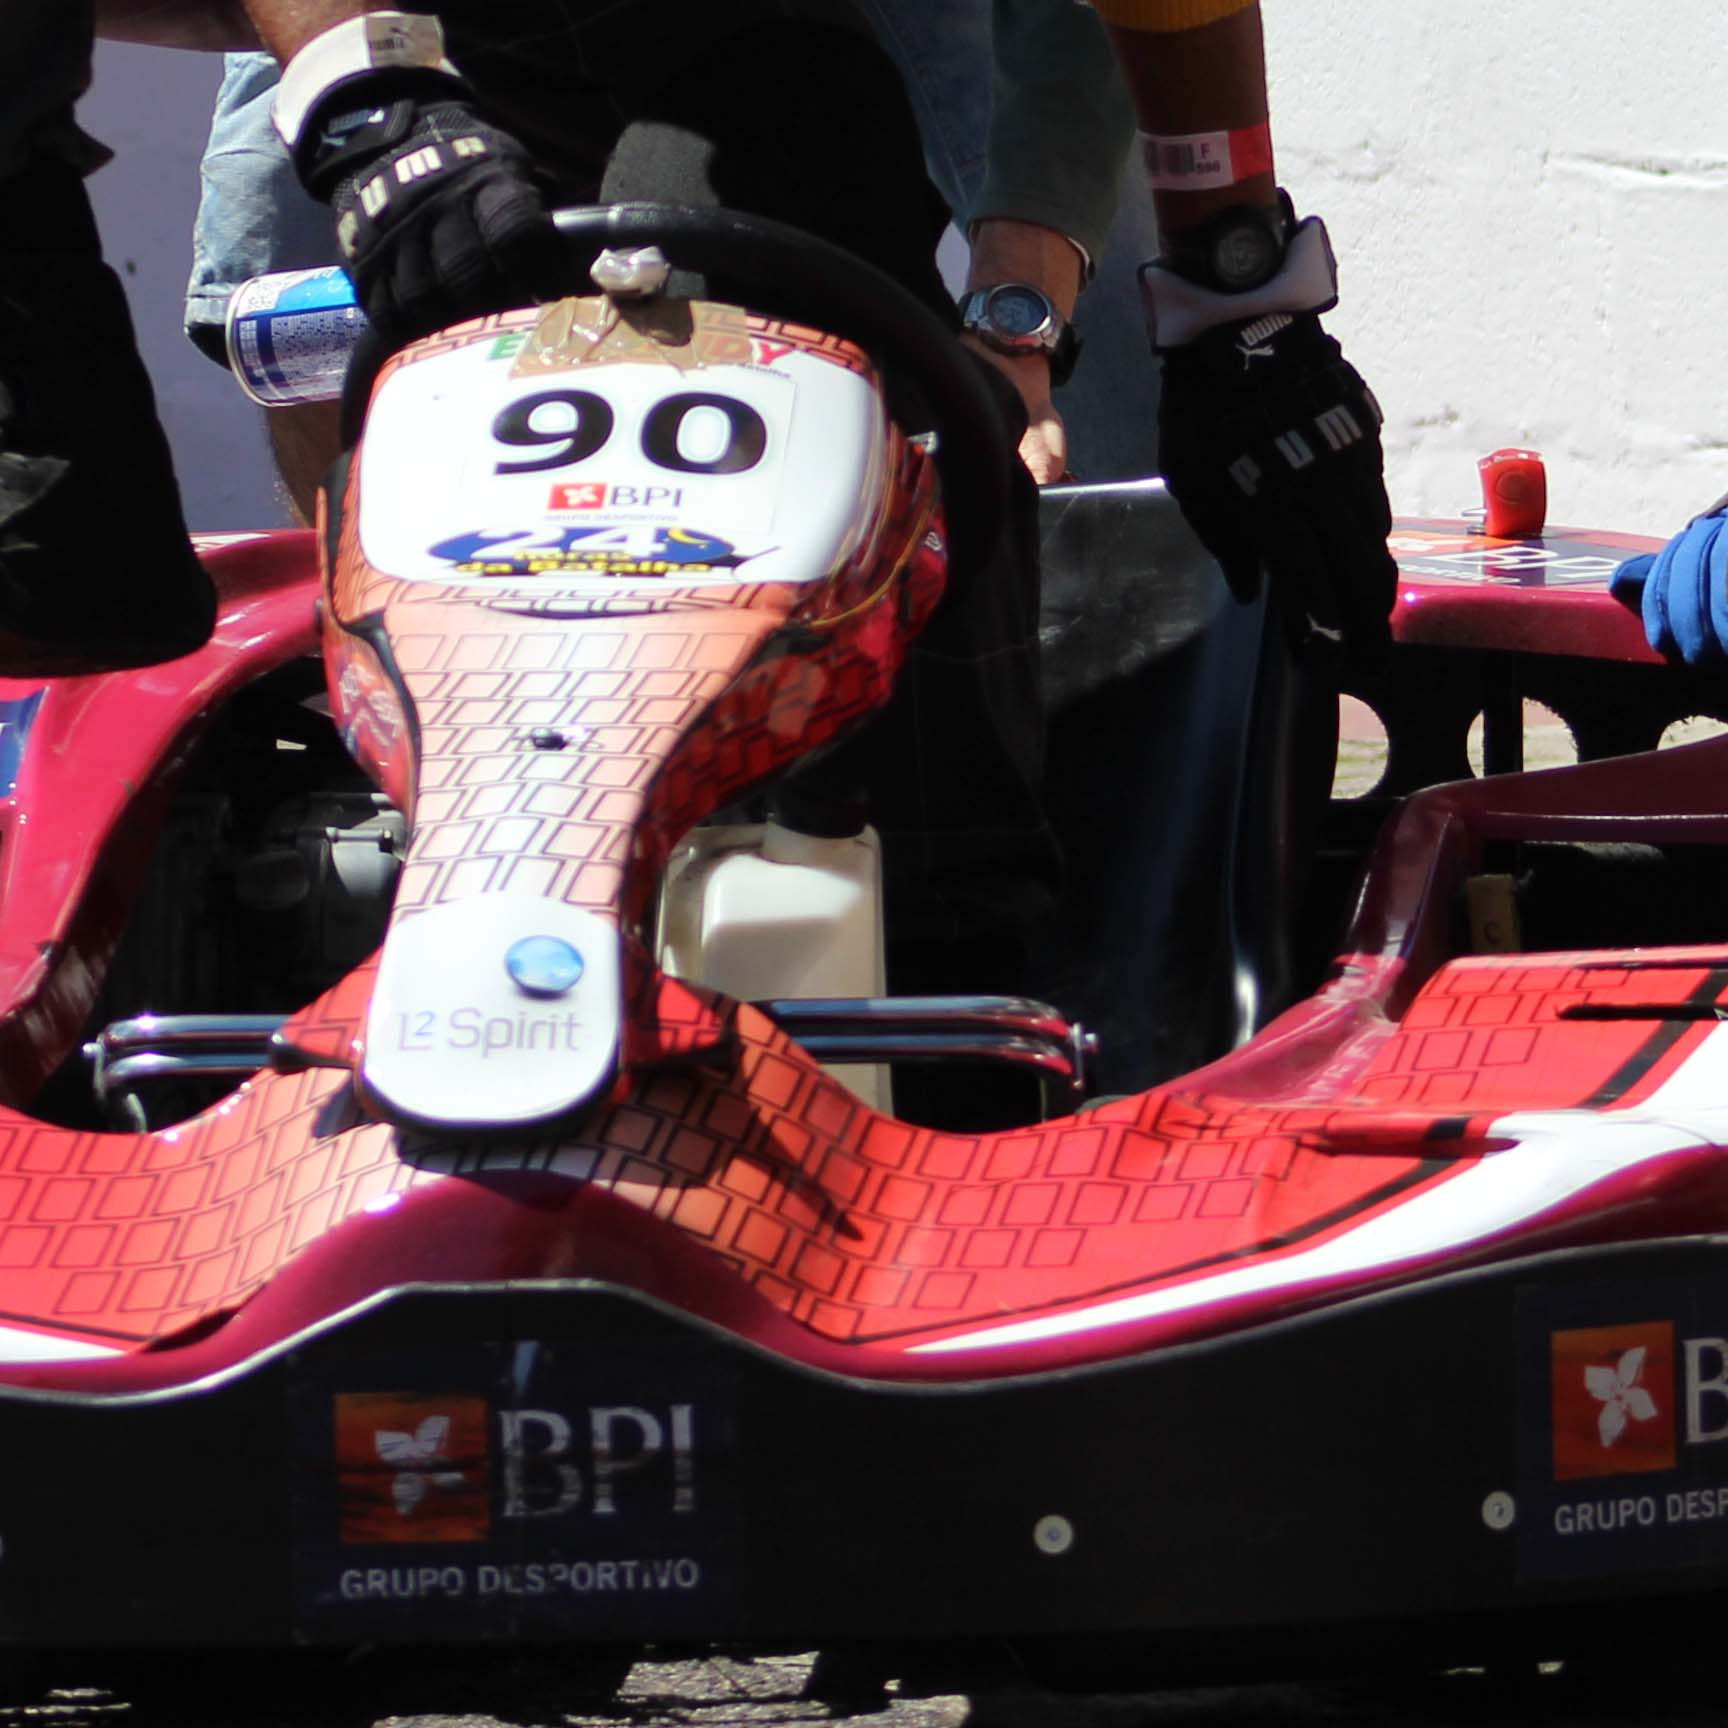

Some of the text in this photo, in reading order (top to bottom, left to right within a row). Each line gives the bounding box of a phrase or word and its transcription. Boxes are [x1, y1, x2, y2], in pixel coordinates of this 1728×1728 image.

[491, 388, 768, 476] 90
[609, 486, 683, 508] BPI
[469, 526, 668, 560] 24
[447, 1007, 584, 1058] Spirit
[499, 1403, 694, 1518] BPI
[1554, 1495, 1656, 1534] GRUPO
[339, 1558, 700, 1600] GRUPO DESPORTIVO
